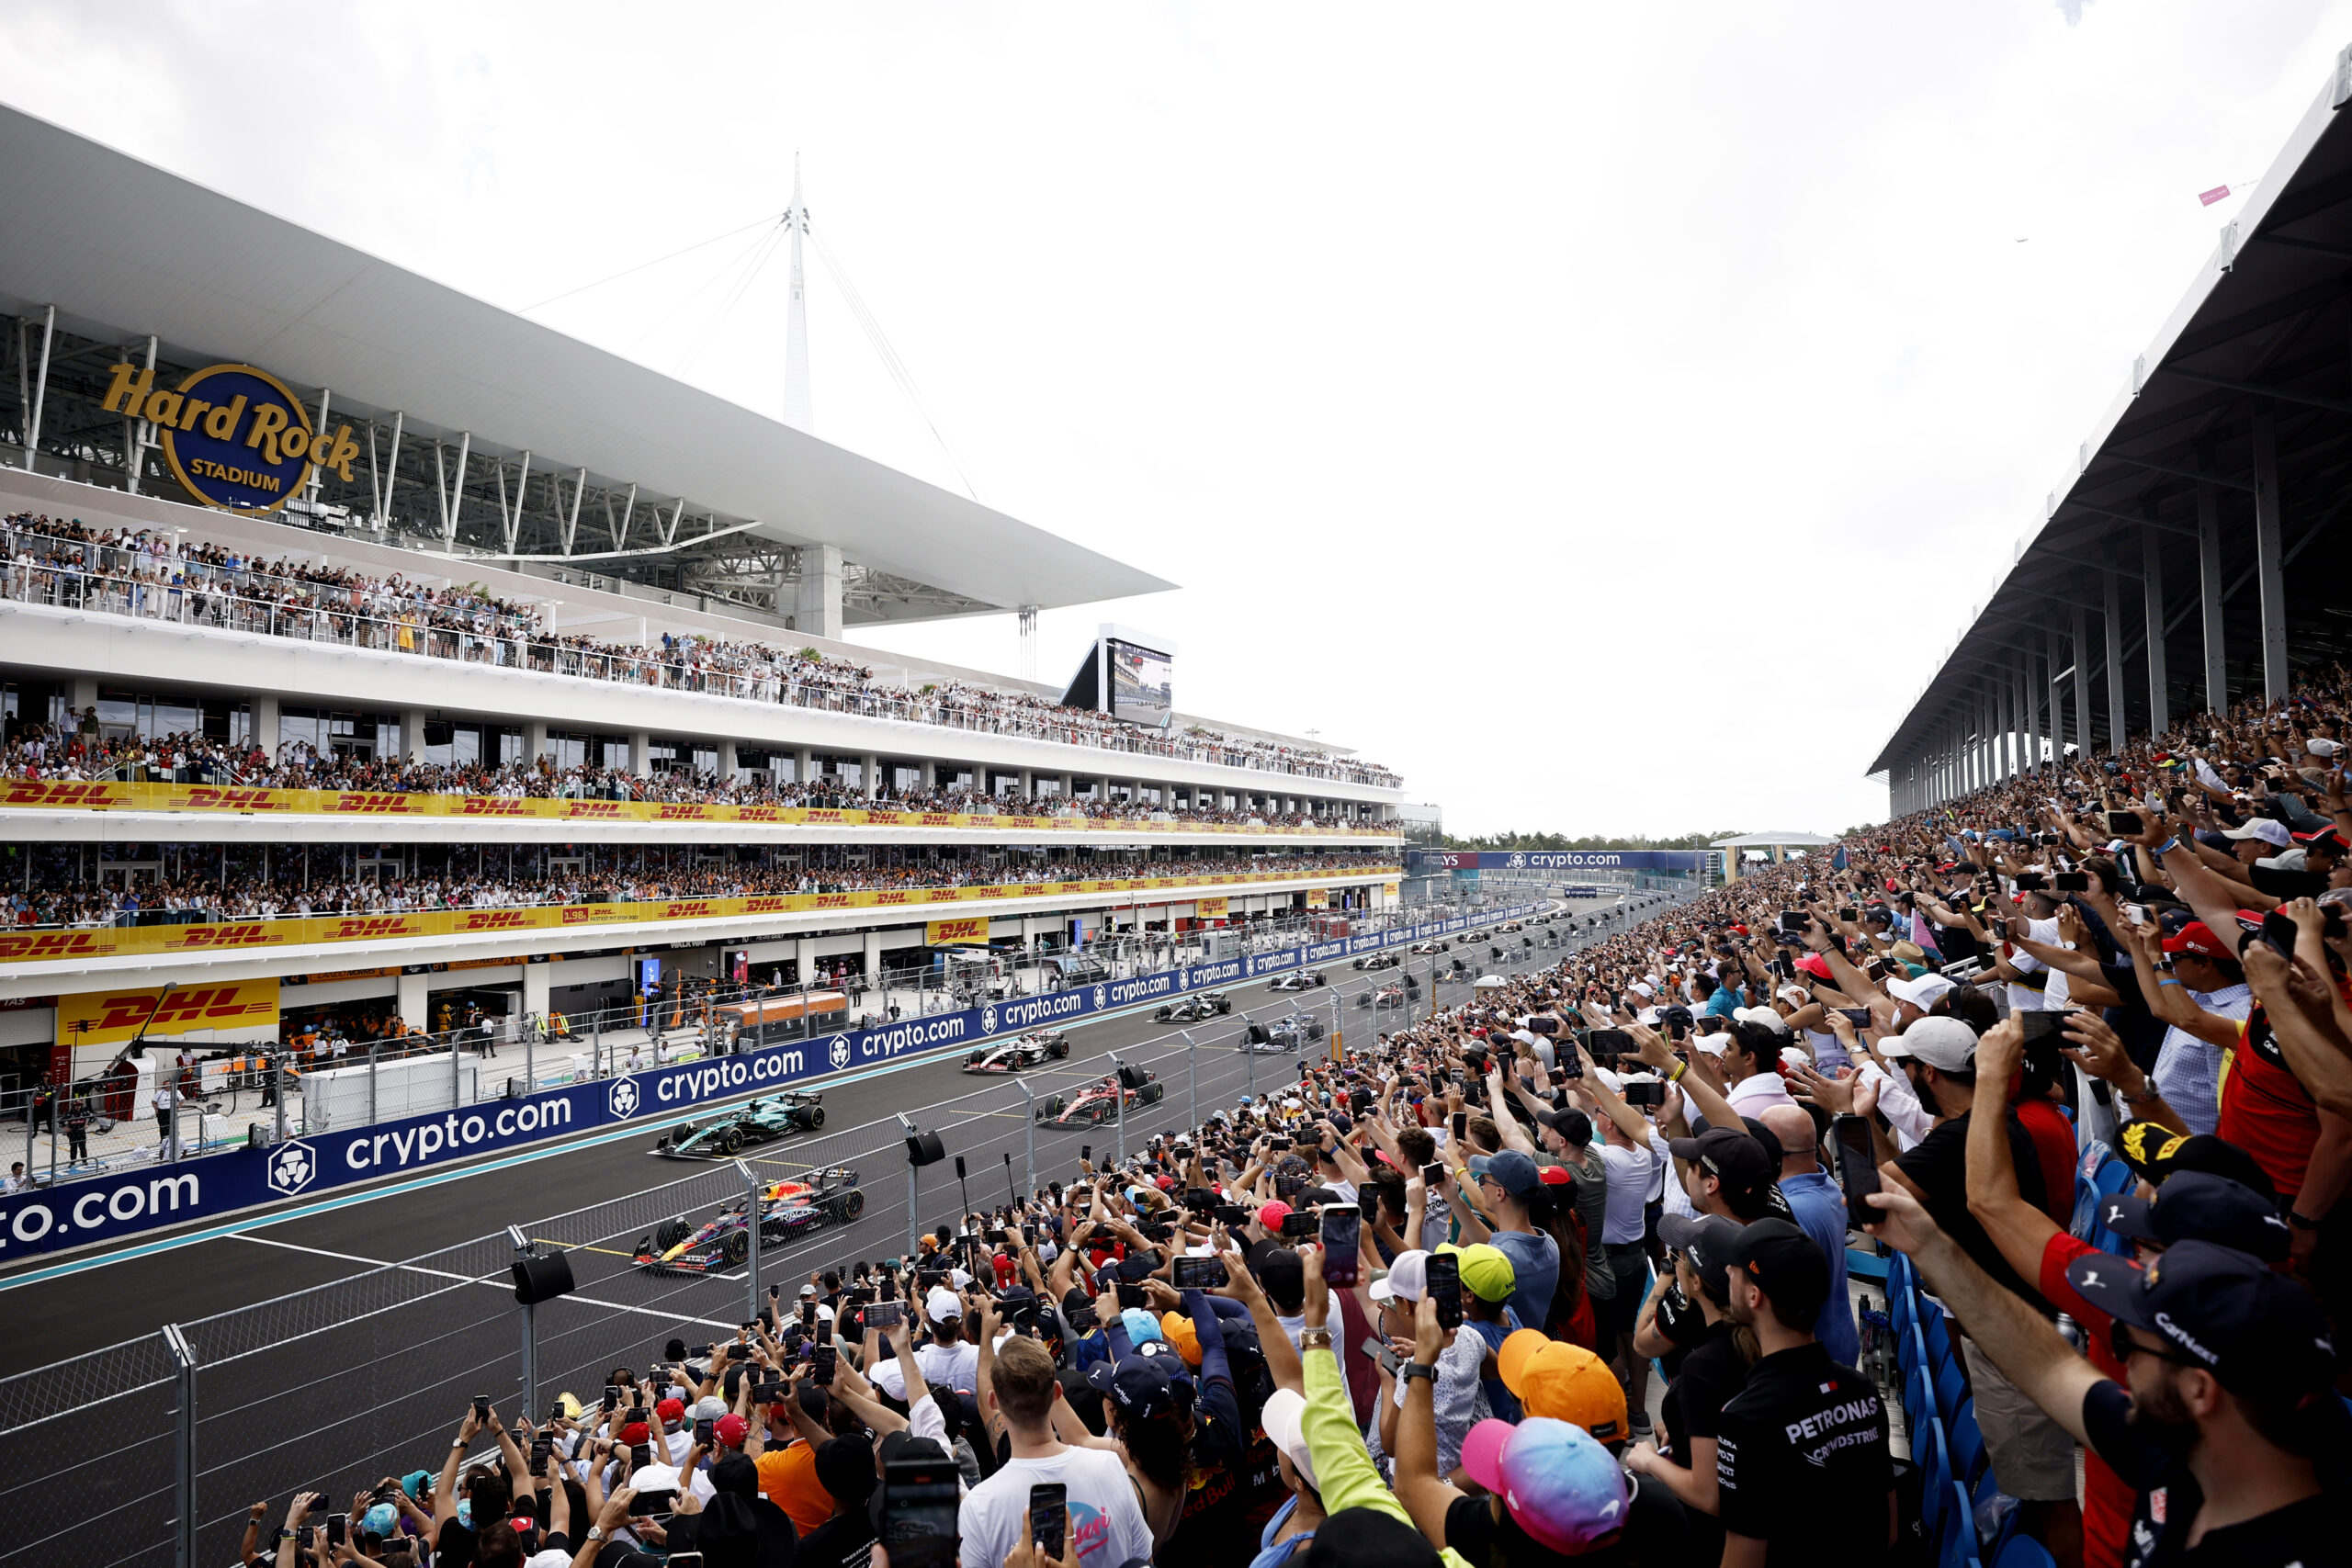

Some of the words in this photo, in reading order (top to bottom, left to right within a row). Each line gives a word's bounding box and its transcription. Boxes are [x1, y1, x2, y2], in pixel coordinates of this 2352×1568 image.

[100, 363, 248, 442] Hard
[244, 402, 360, 482] Rock
[190, 458, 280, 493] STADIUM
[5, 783, 113, 806] DHL
[188, 789, 276, 809] DHL
[338, 795, 411, 813] DHL
[463, 799, 526, 815] DHL
[570, 802, 621, 817] DHL
[659, 805, 703, 819] DHL
[739, 807, 778, 822] DHL
[808, 811, 841, 823] DHL
[868, 813, 898, 824] DHL
[922, 815, 948, 826] DHL
[970, 816, 993, 827] DHL
[1442, 855, 1458, 866] YS
[1532, 852, 1621, 868] crypto.com
[817, 896, 851, 908] DHL
[877, 893, 907, 905] DHL
[932, 891, 958, 902] DHL
[980, 888, 1002, 897] DHL
[667, 903, 711, 918] DHL
[746, 898, 786, 912] DHL
[1203, 899, 1225, 912] DHL
[337, 918, 409, 938] DHL
[467, 910, 526, 930] DHL
[183, 926, 270, 947] DHL
[938, 921, 980, 940] DHL
[1389, 928, 1413, 944] crypto.com
[0, 933, 96, 958] DHL
[670, 941, 691, 949] WALK
[1309, 942, 1341, 961] crypto.com
[1352, 935, 1380, 952] crypto.com
[1257, 952, 1295, 971] crypto.com
[317, 970, 345, 980] LANDO
[346, 967, 376, 978] NORRIS
[1193, 963, 1239, 987] crypto.com
[1112, 976, 1170, 1004] crypto.com
[98, 987, 248, 1030] DHL
[1006, 994, 1080, 1031] crypto.com
[863, 1017, 965, 1058] crypto.com
[658, 1051, 803, 1101] crypto.com
[346, 1098, 571, 1170] crypto.com
[0, 1171, 199, 1247] o.com
[2154, 1312, 2220, 1366] CarNext
[1114, 1382, 1132, 1405] CarNext
[1784, 1396, 1879, 1445] PETRONAS
[1205, 1472, 1236, 1506] Bull
